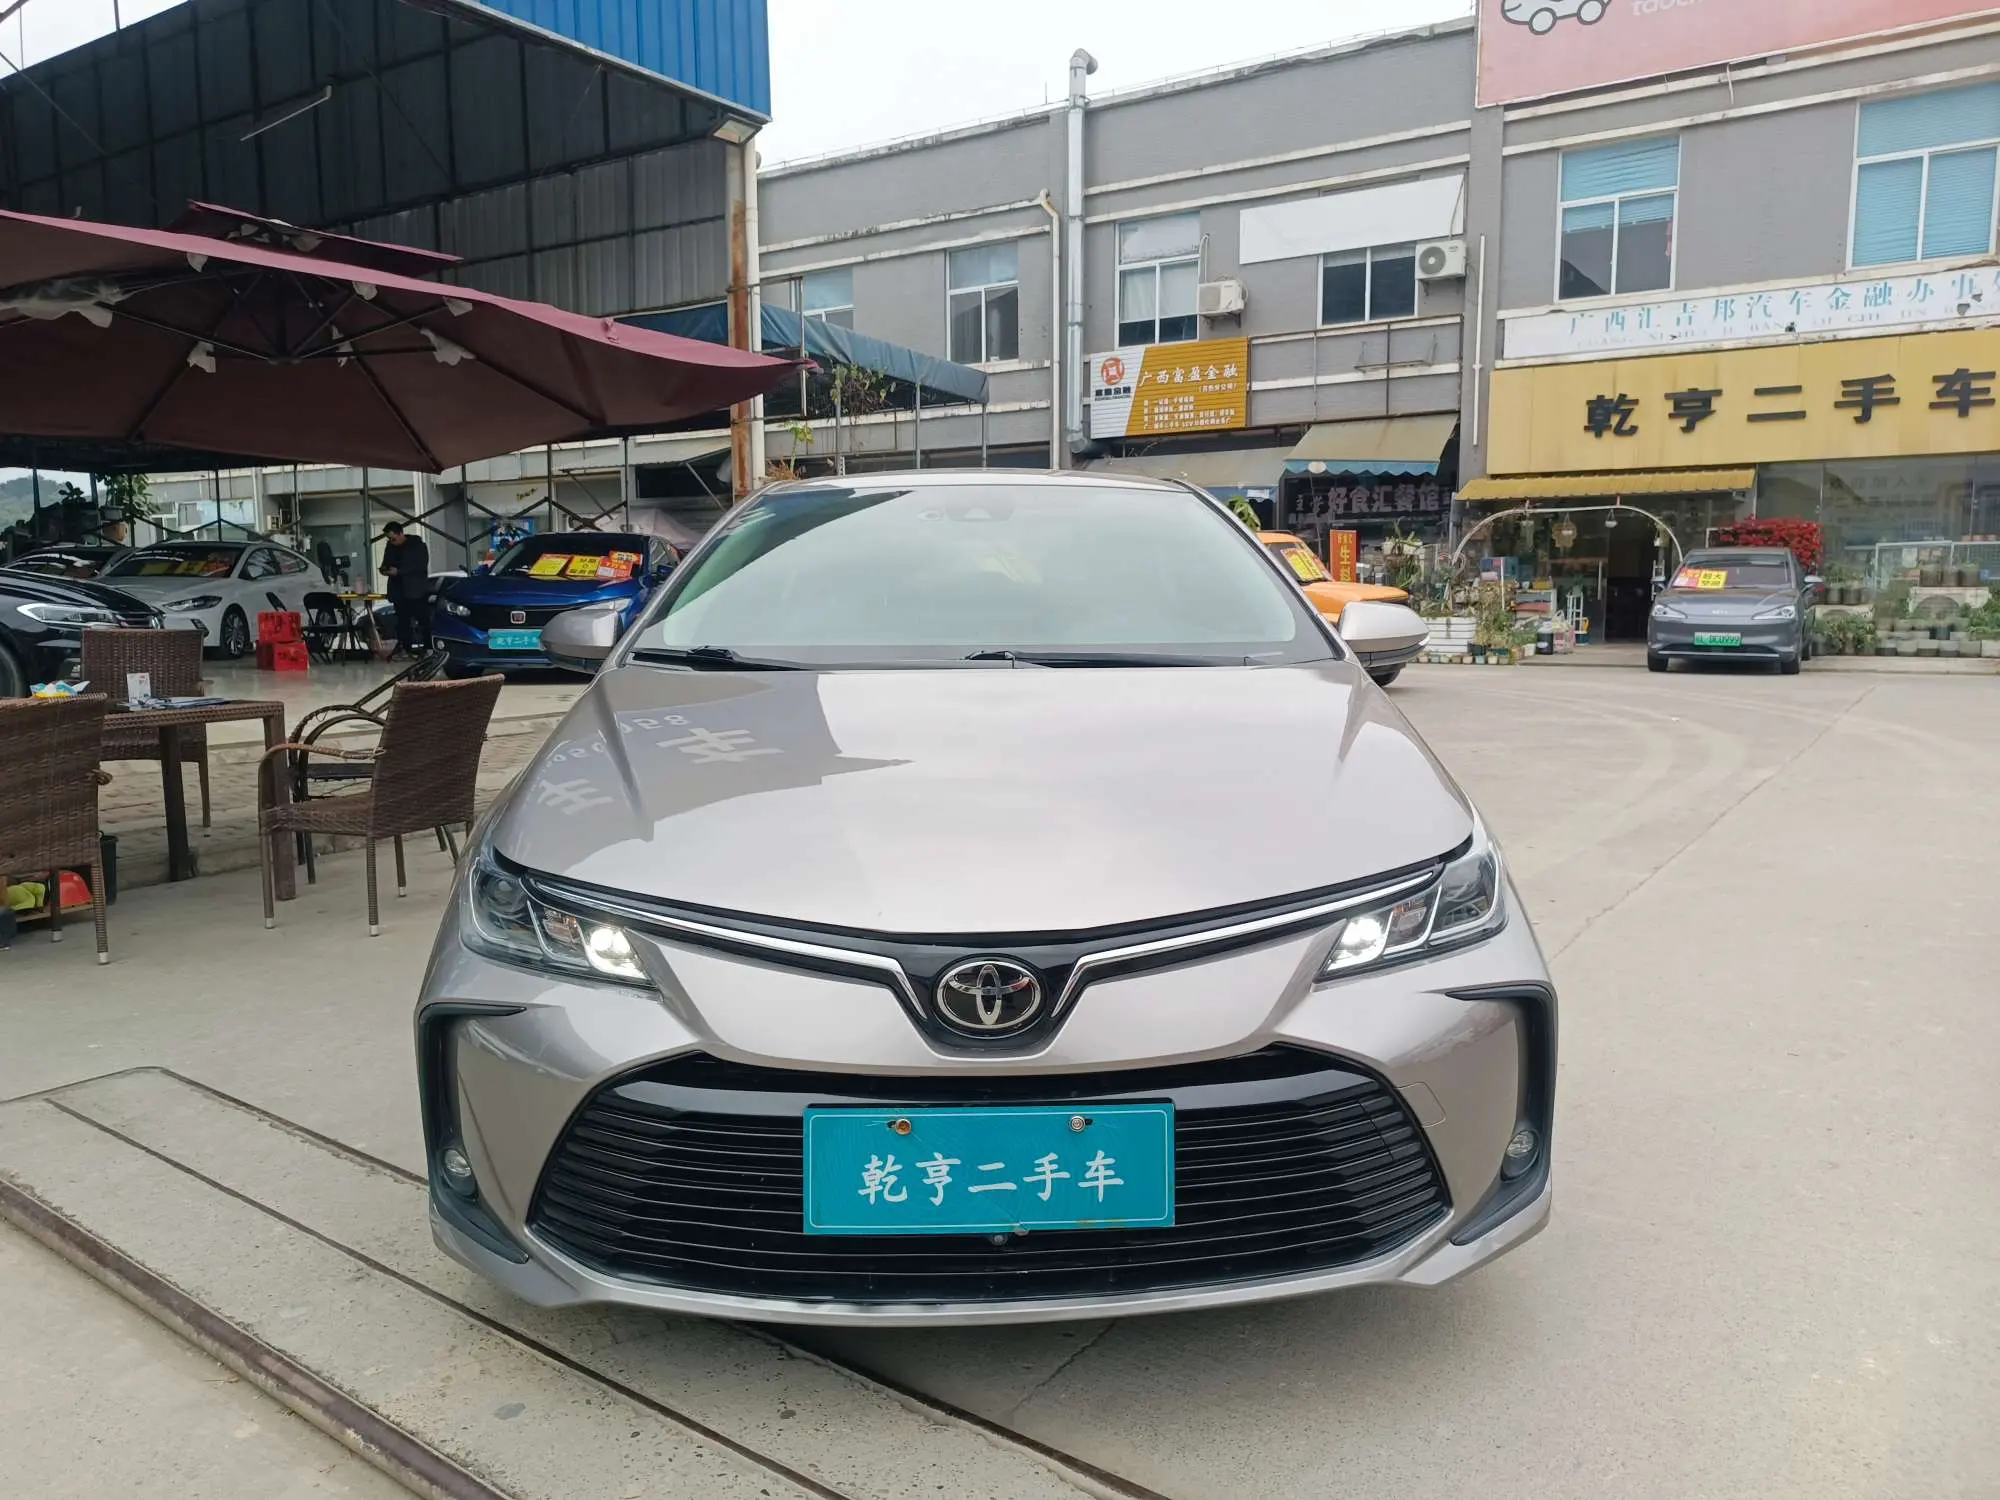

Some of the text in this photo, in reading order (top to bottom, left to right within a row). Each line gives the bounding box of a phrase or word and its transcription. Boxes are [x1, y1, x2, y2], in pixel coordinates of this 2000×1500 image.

[1138, 360, 1239, 387] 广西富盈金融
[1584, 367, 1996, 438] 乾亨二手车
[857, 1149, 1125, 1207] 乾亨二手车
